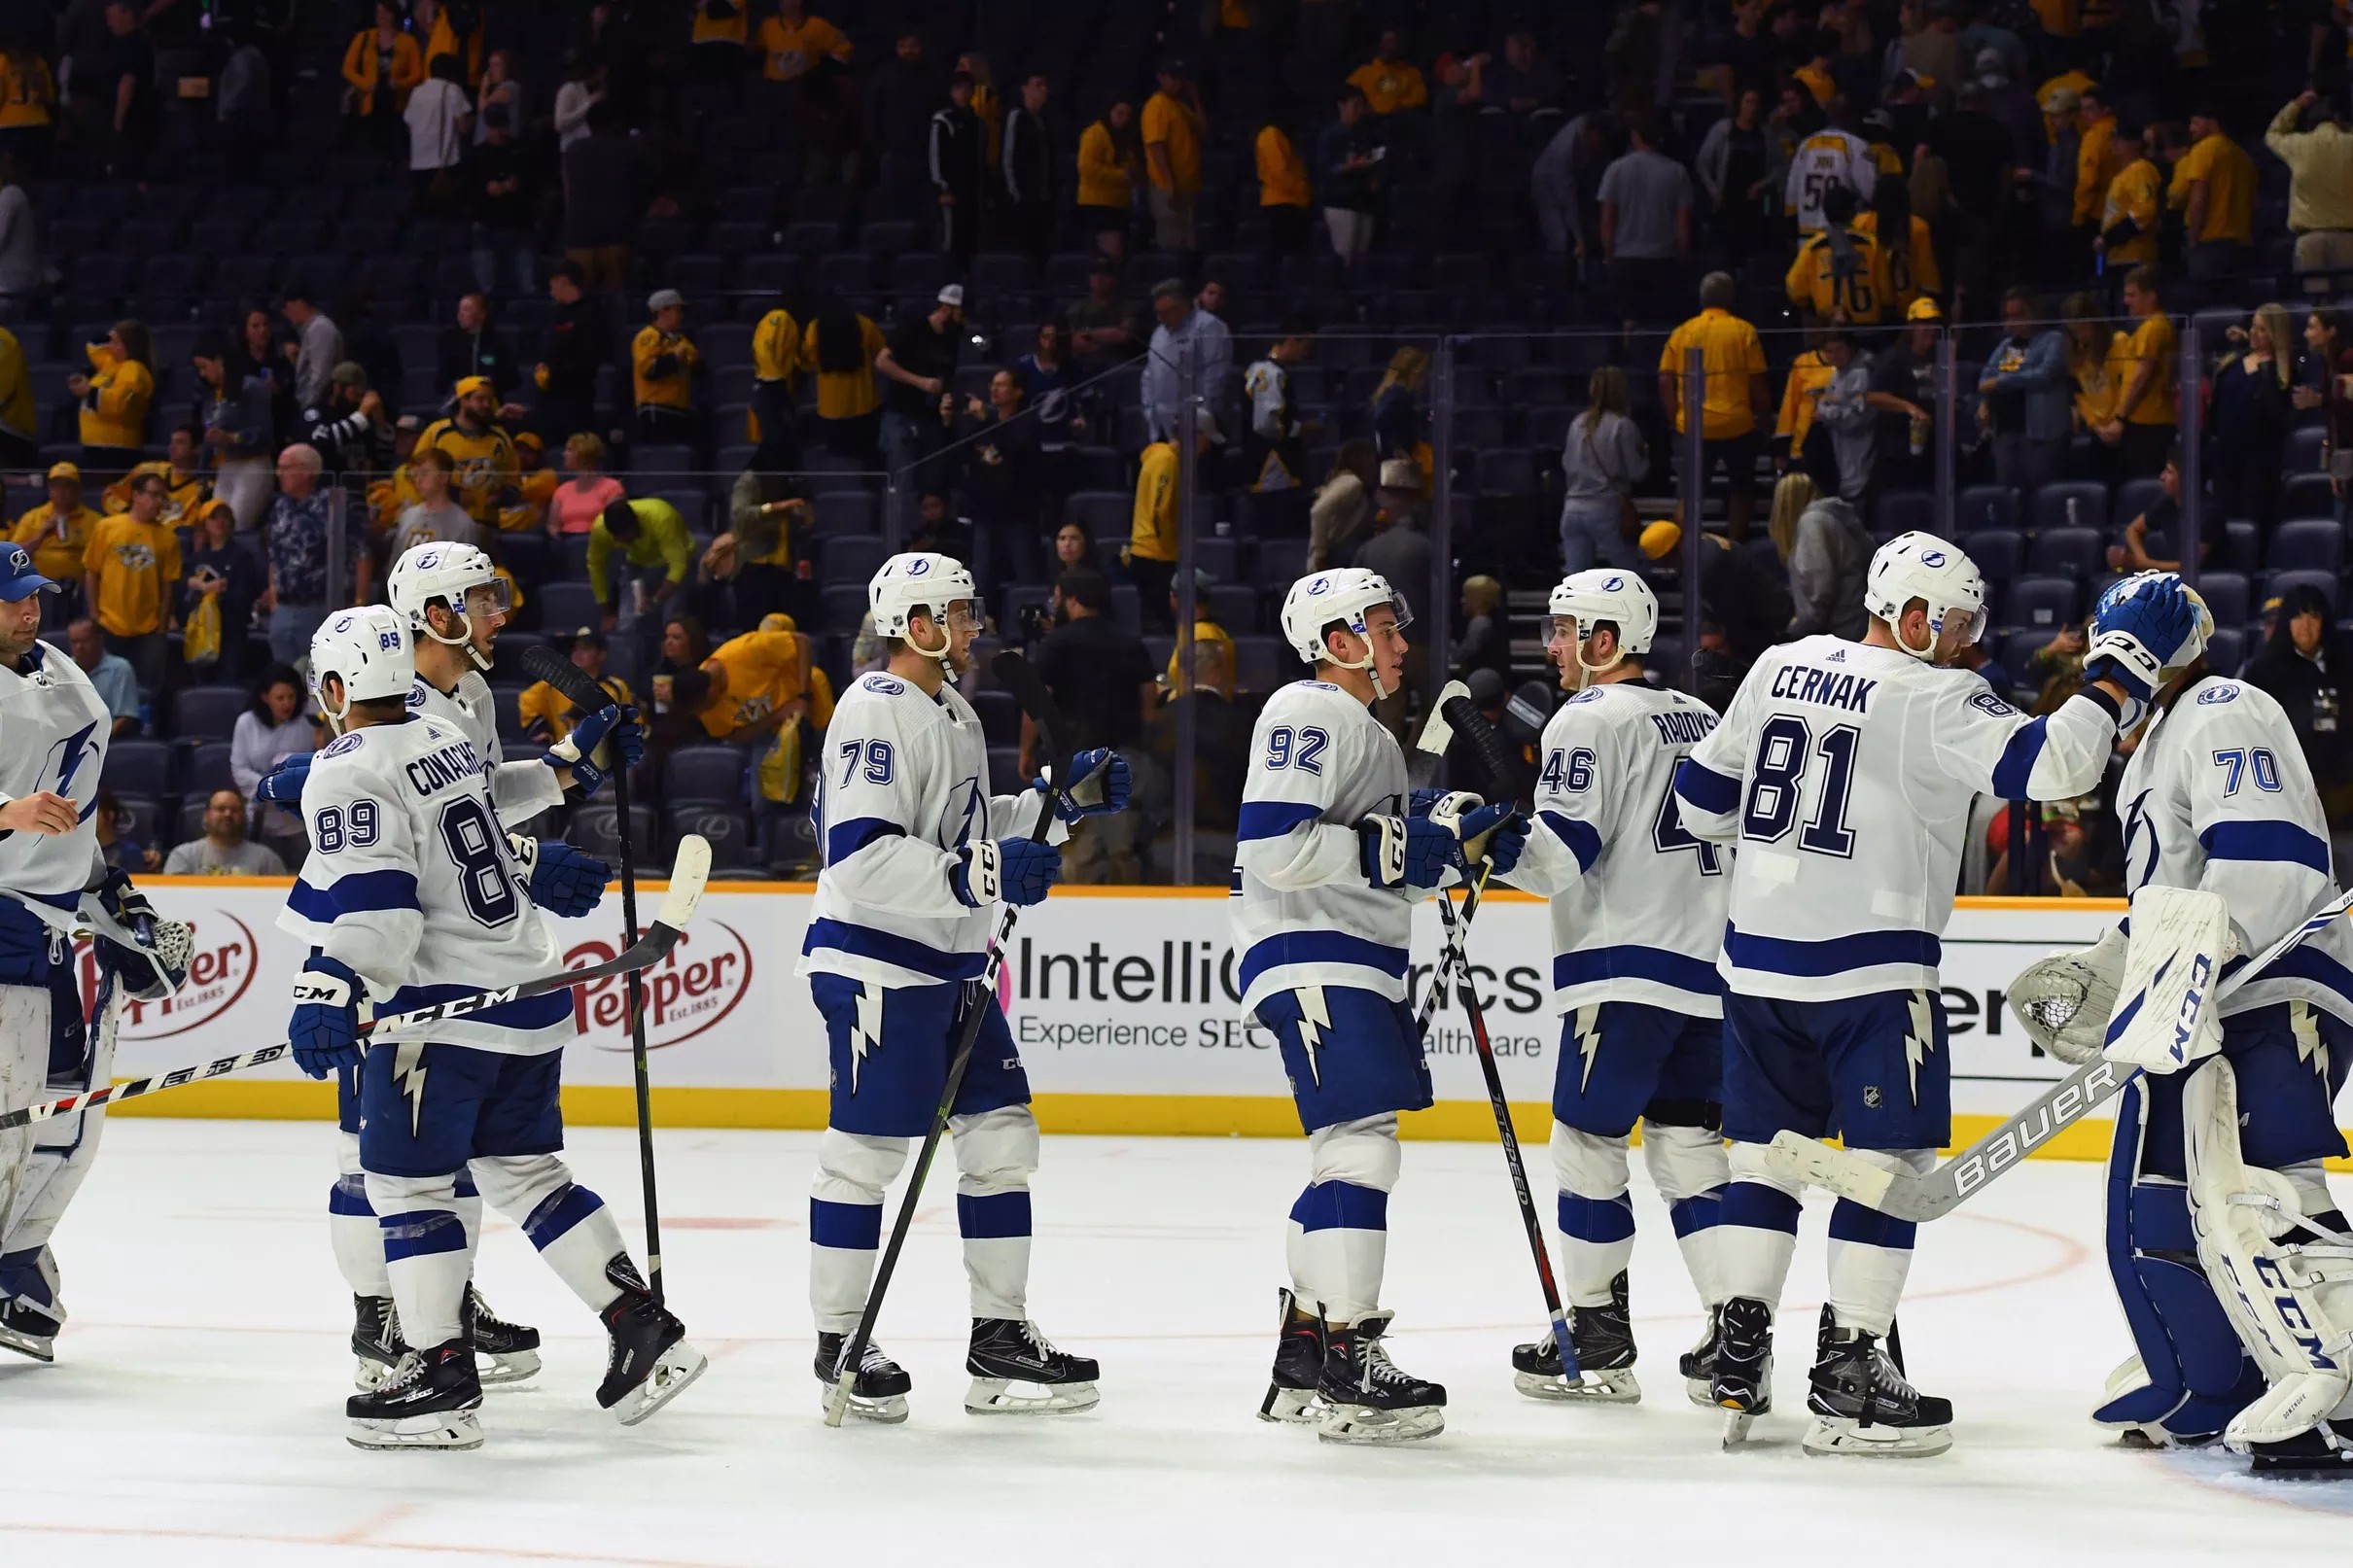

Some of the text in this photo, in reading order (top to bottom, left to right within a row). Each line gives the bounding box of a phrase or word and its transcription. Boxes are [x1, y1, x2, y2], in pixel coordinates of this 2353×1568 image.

[380, 632, 400, 648] 89
[1772, 665, 1878, 714] CERNAK
[1970, 691, 2020, 717] 8
[840, 738, 895, 789] 79
[1265, 725, 1329, 777] 92
[1540, 748, 1596, 794] 46
[2212, 747, 2283, 798] 70
[1742, 713, 1861, 859] 81
[314, 799, 379, 854] 89
[1388, 817, 1404, 872] CC
[438, 785, 537, 929] 8
[401, 984, 521, 1028] CCM
[2169, 952, 2212, 1063] CCM
[1020, 1016, 1187, 1050] Experience
[1491, 1092, 1528, 1205] JETSPEED
[2252, 1255, 2339, 1371] CCM
[1018, 1357, 1042, 1368] BAUER
[2282, 1392, 2307, 1420] DOMINGUE
